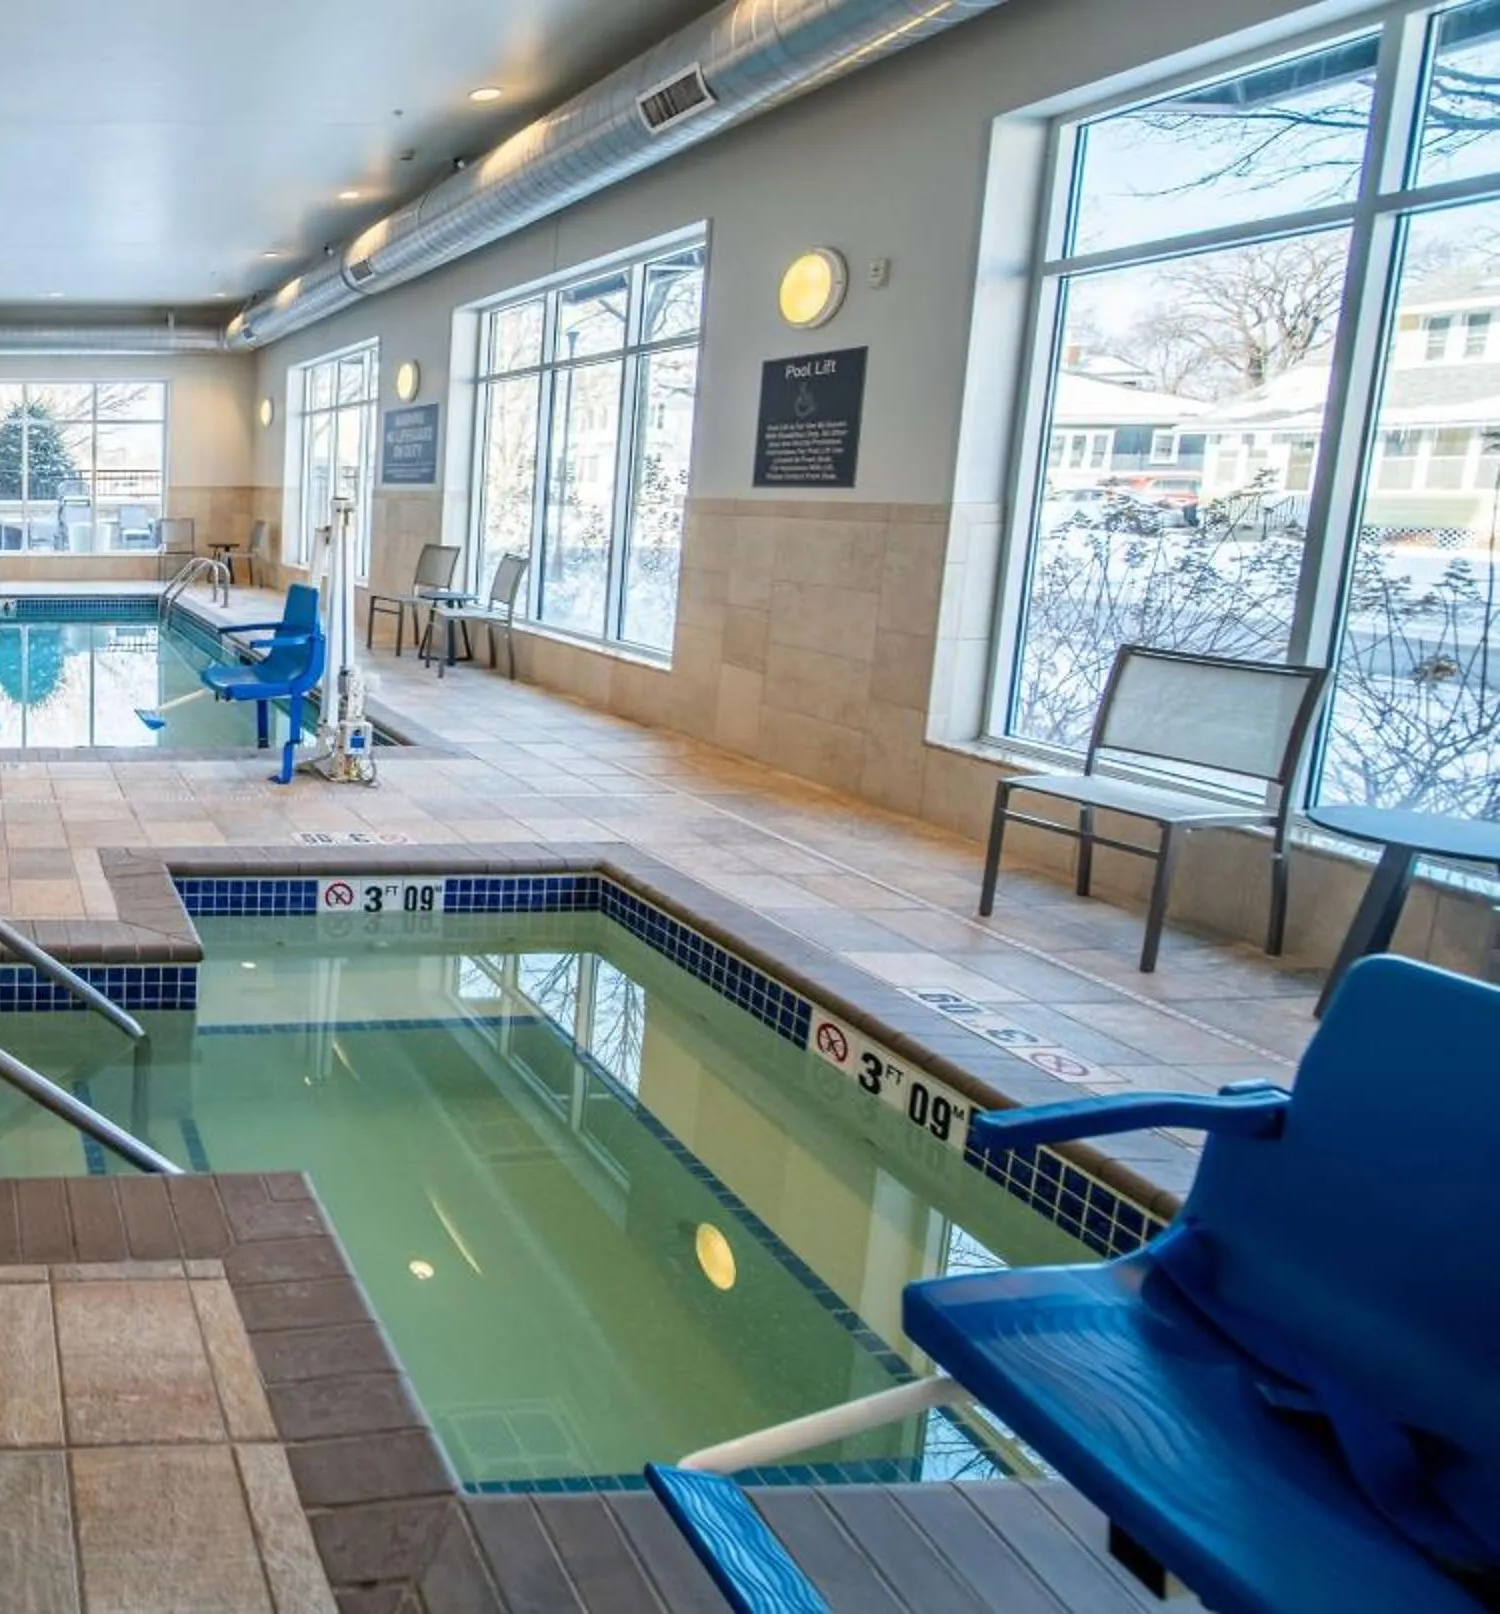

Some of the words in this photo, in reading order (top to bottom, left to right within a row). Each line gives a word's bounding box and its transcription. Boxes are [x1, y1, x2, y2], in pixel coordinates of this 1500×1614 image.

[785, 362, 811, 379] Pool
[815, 359, 836, 376] Lift
[364, 885, 382, 913] 3
[858, 1052, 882, 1095] 3
